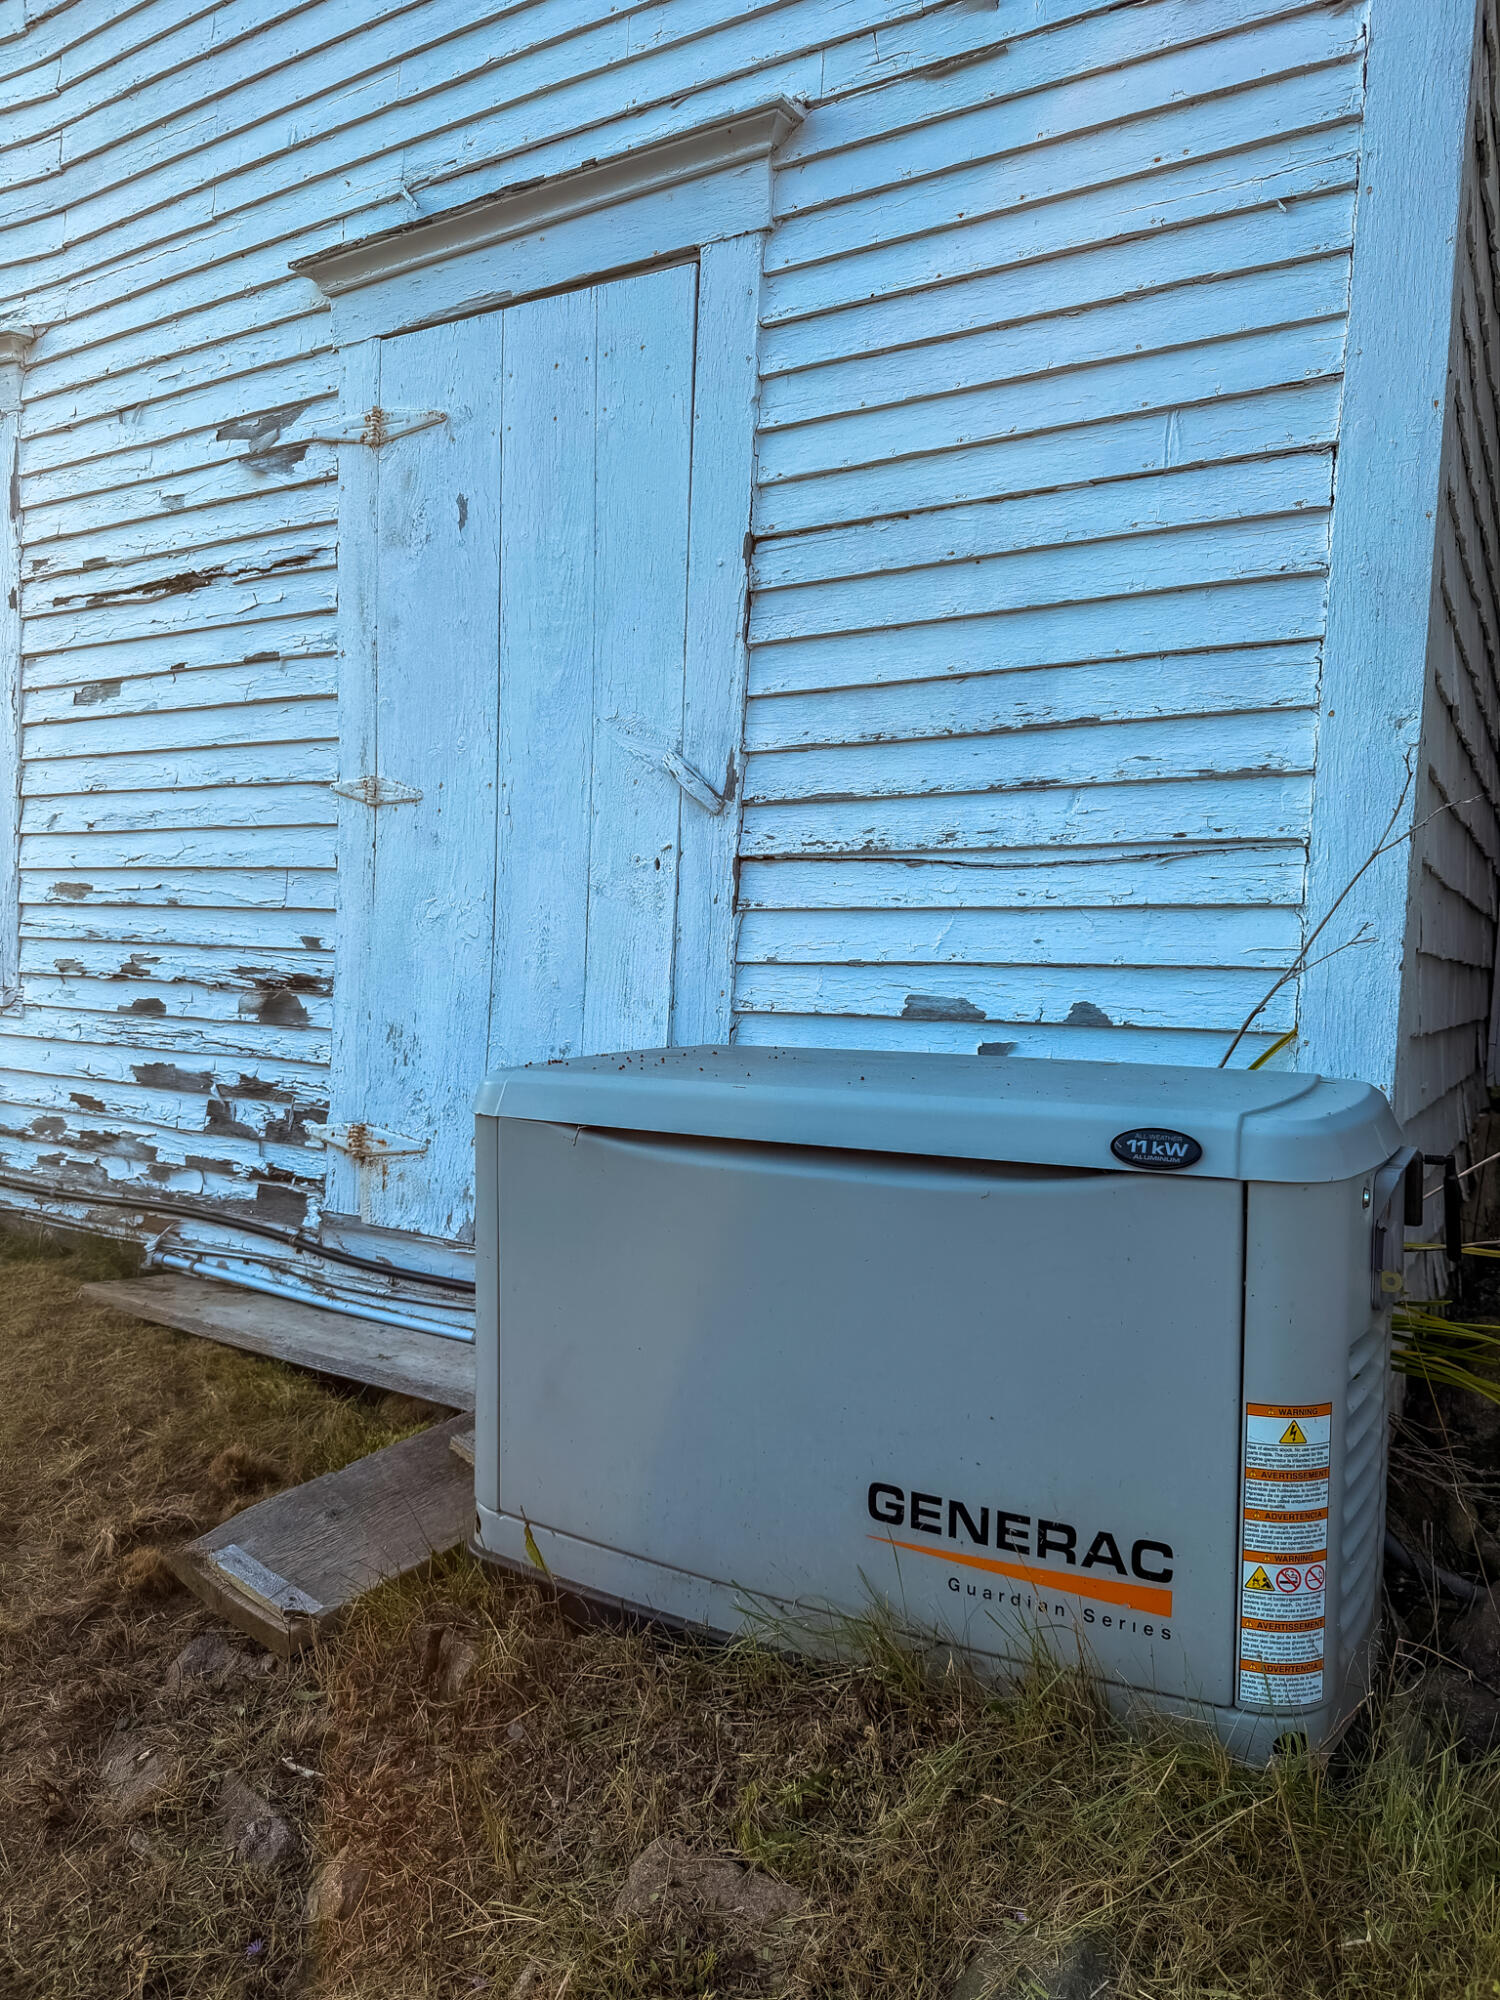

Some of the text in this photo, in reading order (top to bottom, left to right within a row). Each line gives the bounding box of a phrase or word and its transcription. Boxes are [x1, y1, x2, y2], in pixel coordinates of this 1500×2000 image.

[1127, 1139, 1189, 1157] 11 kW
[1133, 1154, 1180, 1163] ALUMINUM
[1278, 1408, 1318, 1416] WARNING
[1261, 1470, 1328, 1479] AVERTISSEMENT
[1265, 1511, 1323, 1520] ADVERTENCIA
[868, 1482, 1174, 1584] GENERAC
[1274, 1553, 1314, 1562] WARNING
[948, 1577, 1172, 1640] Guardian Series
[1256, 1620, 1323, 1631] AVERTISSEMENT
